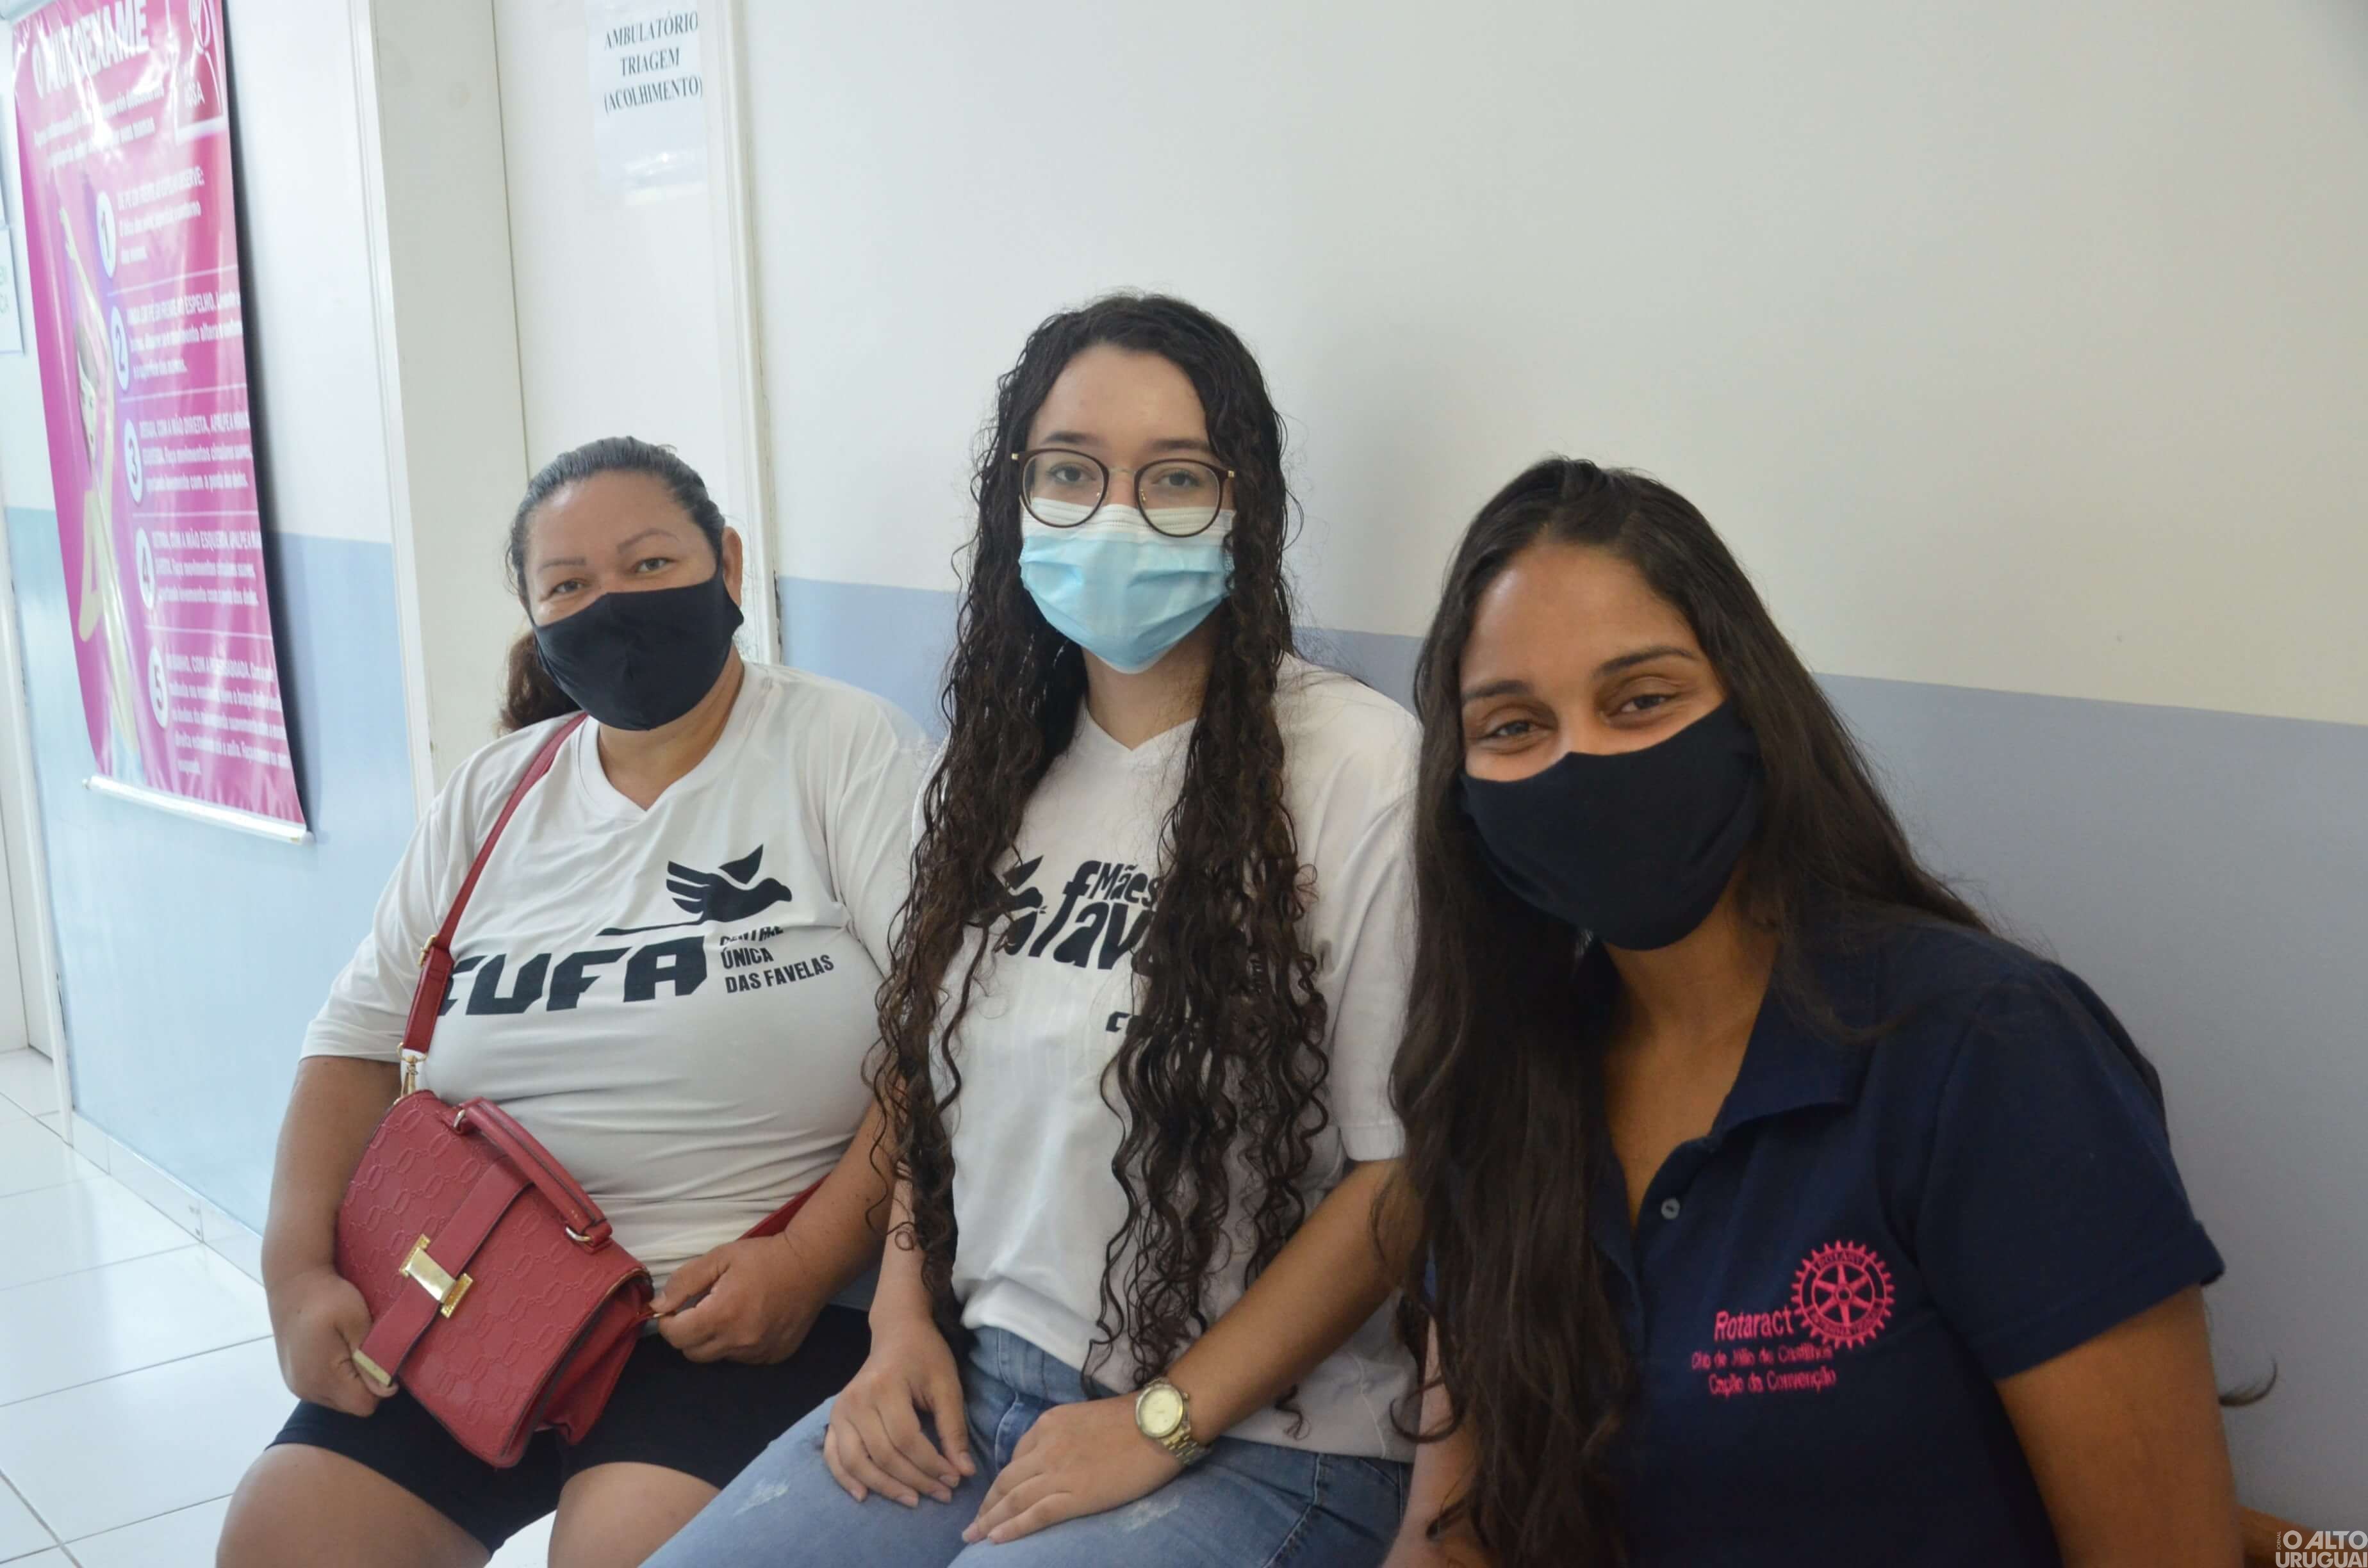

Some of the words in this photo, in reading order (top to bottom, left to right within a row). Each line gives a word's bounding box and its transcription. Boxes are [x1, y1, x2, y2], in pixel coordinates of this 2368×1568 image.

[604, 10, 699, 51] AMBULATÓRIO
[620, 47, 680, 77] TRIAGEM
[604, 74, 703, 116] (ACOLHIMENTO)
[115, 328, 126, 373] 2
[129, 437, 138, 485] 3
[142, 544, 151, 593] 4
[154, 664, 163, 711] 5
[438, 936, 707, 1017] CUFA
[720, 946, 774, 970] ÚNICA
[725, 973, 762, 993] DAS
[764, 954, 834, 987] FAVELAS
[1714, 1306, 1794, 1343] Rotaract
